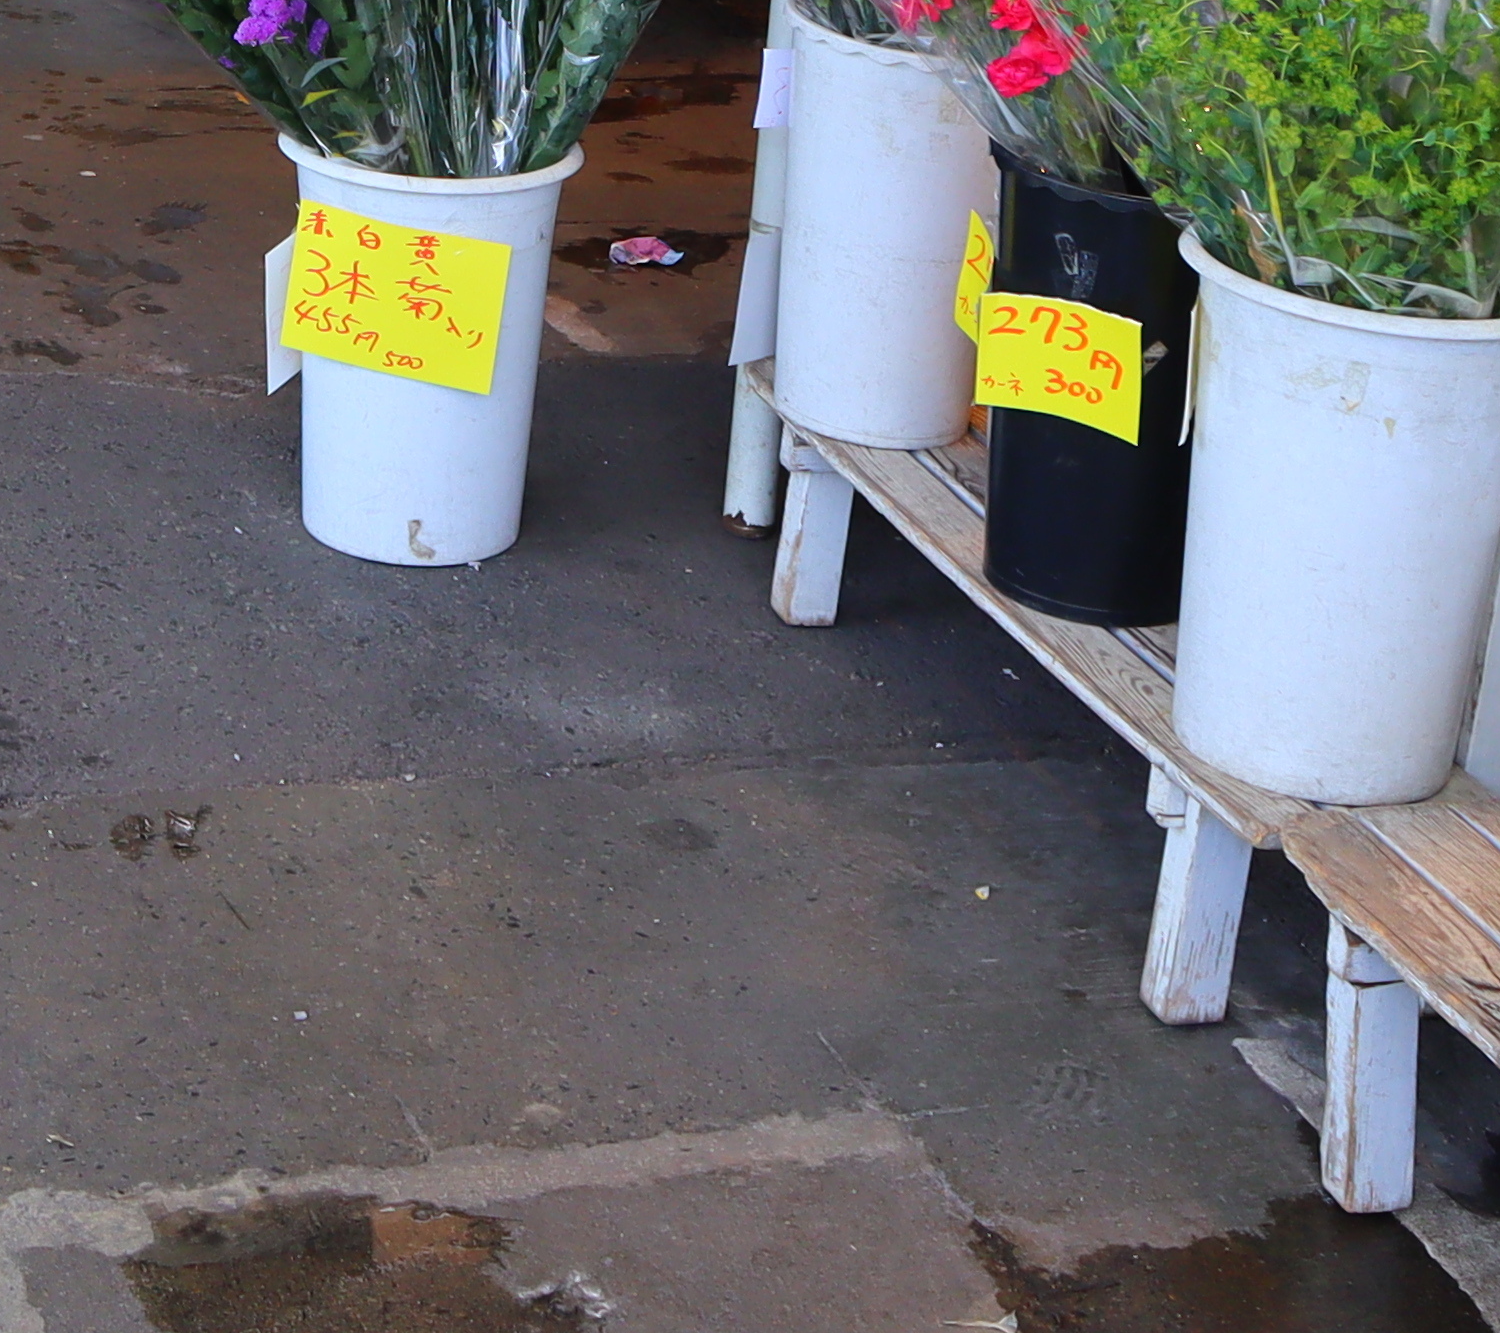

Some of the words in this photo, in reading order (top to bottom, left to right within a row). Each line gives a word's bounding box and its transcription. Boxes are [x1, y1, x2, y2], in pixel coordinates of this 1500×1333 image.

[302, 209, 334, 238] 赤
[357, 224, 381, 250] 白
[405, 235, 441, 277] 黄
[302, 249, 380, 306] 3本
[293, 299, 380, 353] 455円
[987, 305, 1124, 391] 273円
[381, 350, 424, 370] 500
[981, 372, 1024, 397] カーネ
[1043, 368, 1104, 405] 300
